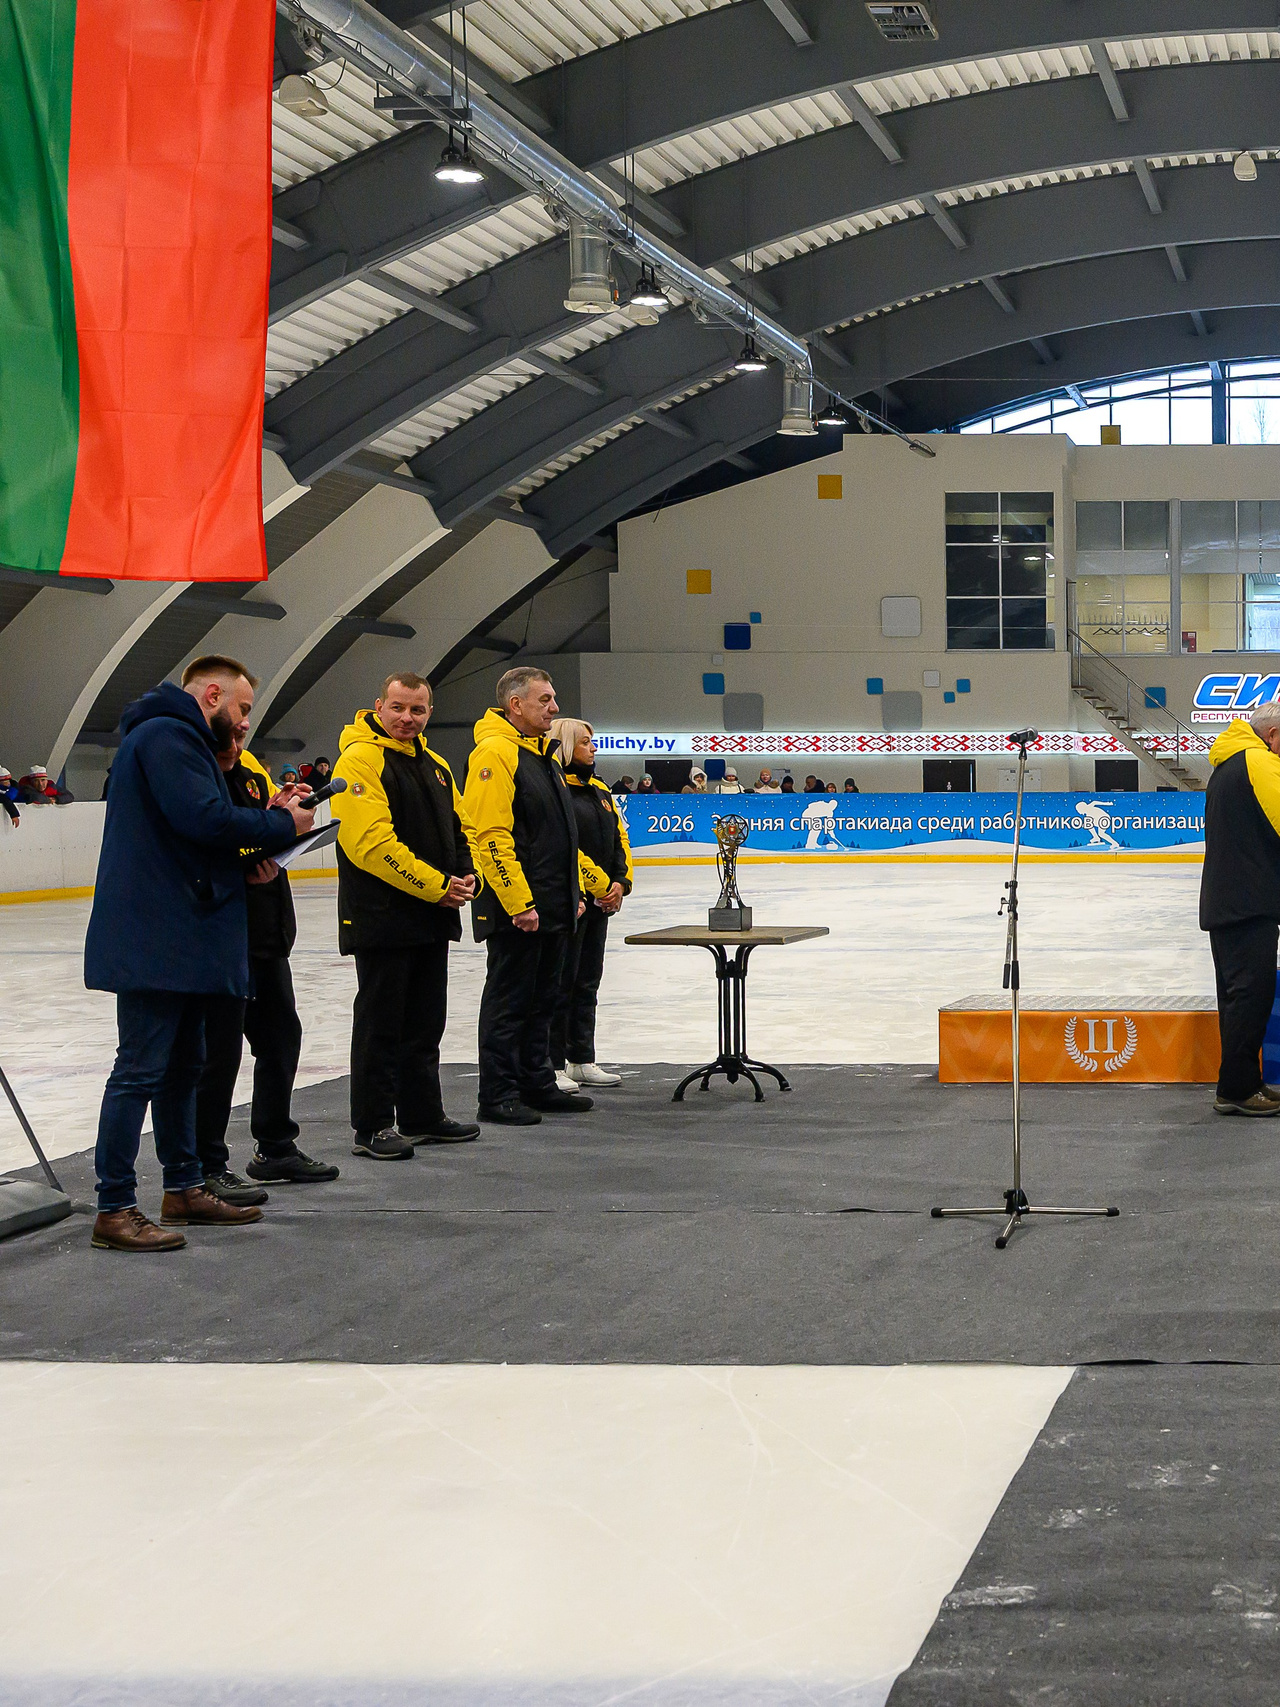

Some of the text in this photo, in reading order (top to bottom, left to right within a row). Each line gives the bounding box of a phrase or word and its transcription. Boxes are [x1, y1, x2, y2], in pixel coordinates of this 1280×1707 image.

[647, 815, 695, 833] 2026
[789, 815, 913, 835] спартакиада
[917, 815, 975, 833] среди
[980, 810, 1095, 833] работников
[383, 854, 426, 890] BELARUS
[488, 840, 512, 888] BELARUS
[1083, 1019, 1119, 1054] II
